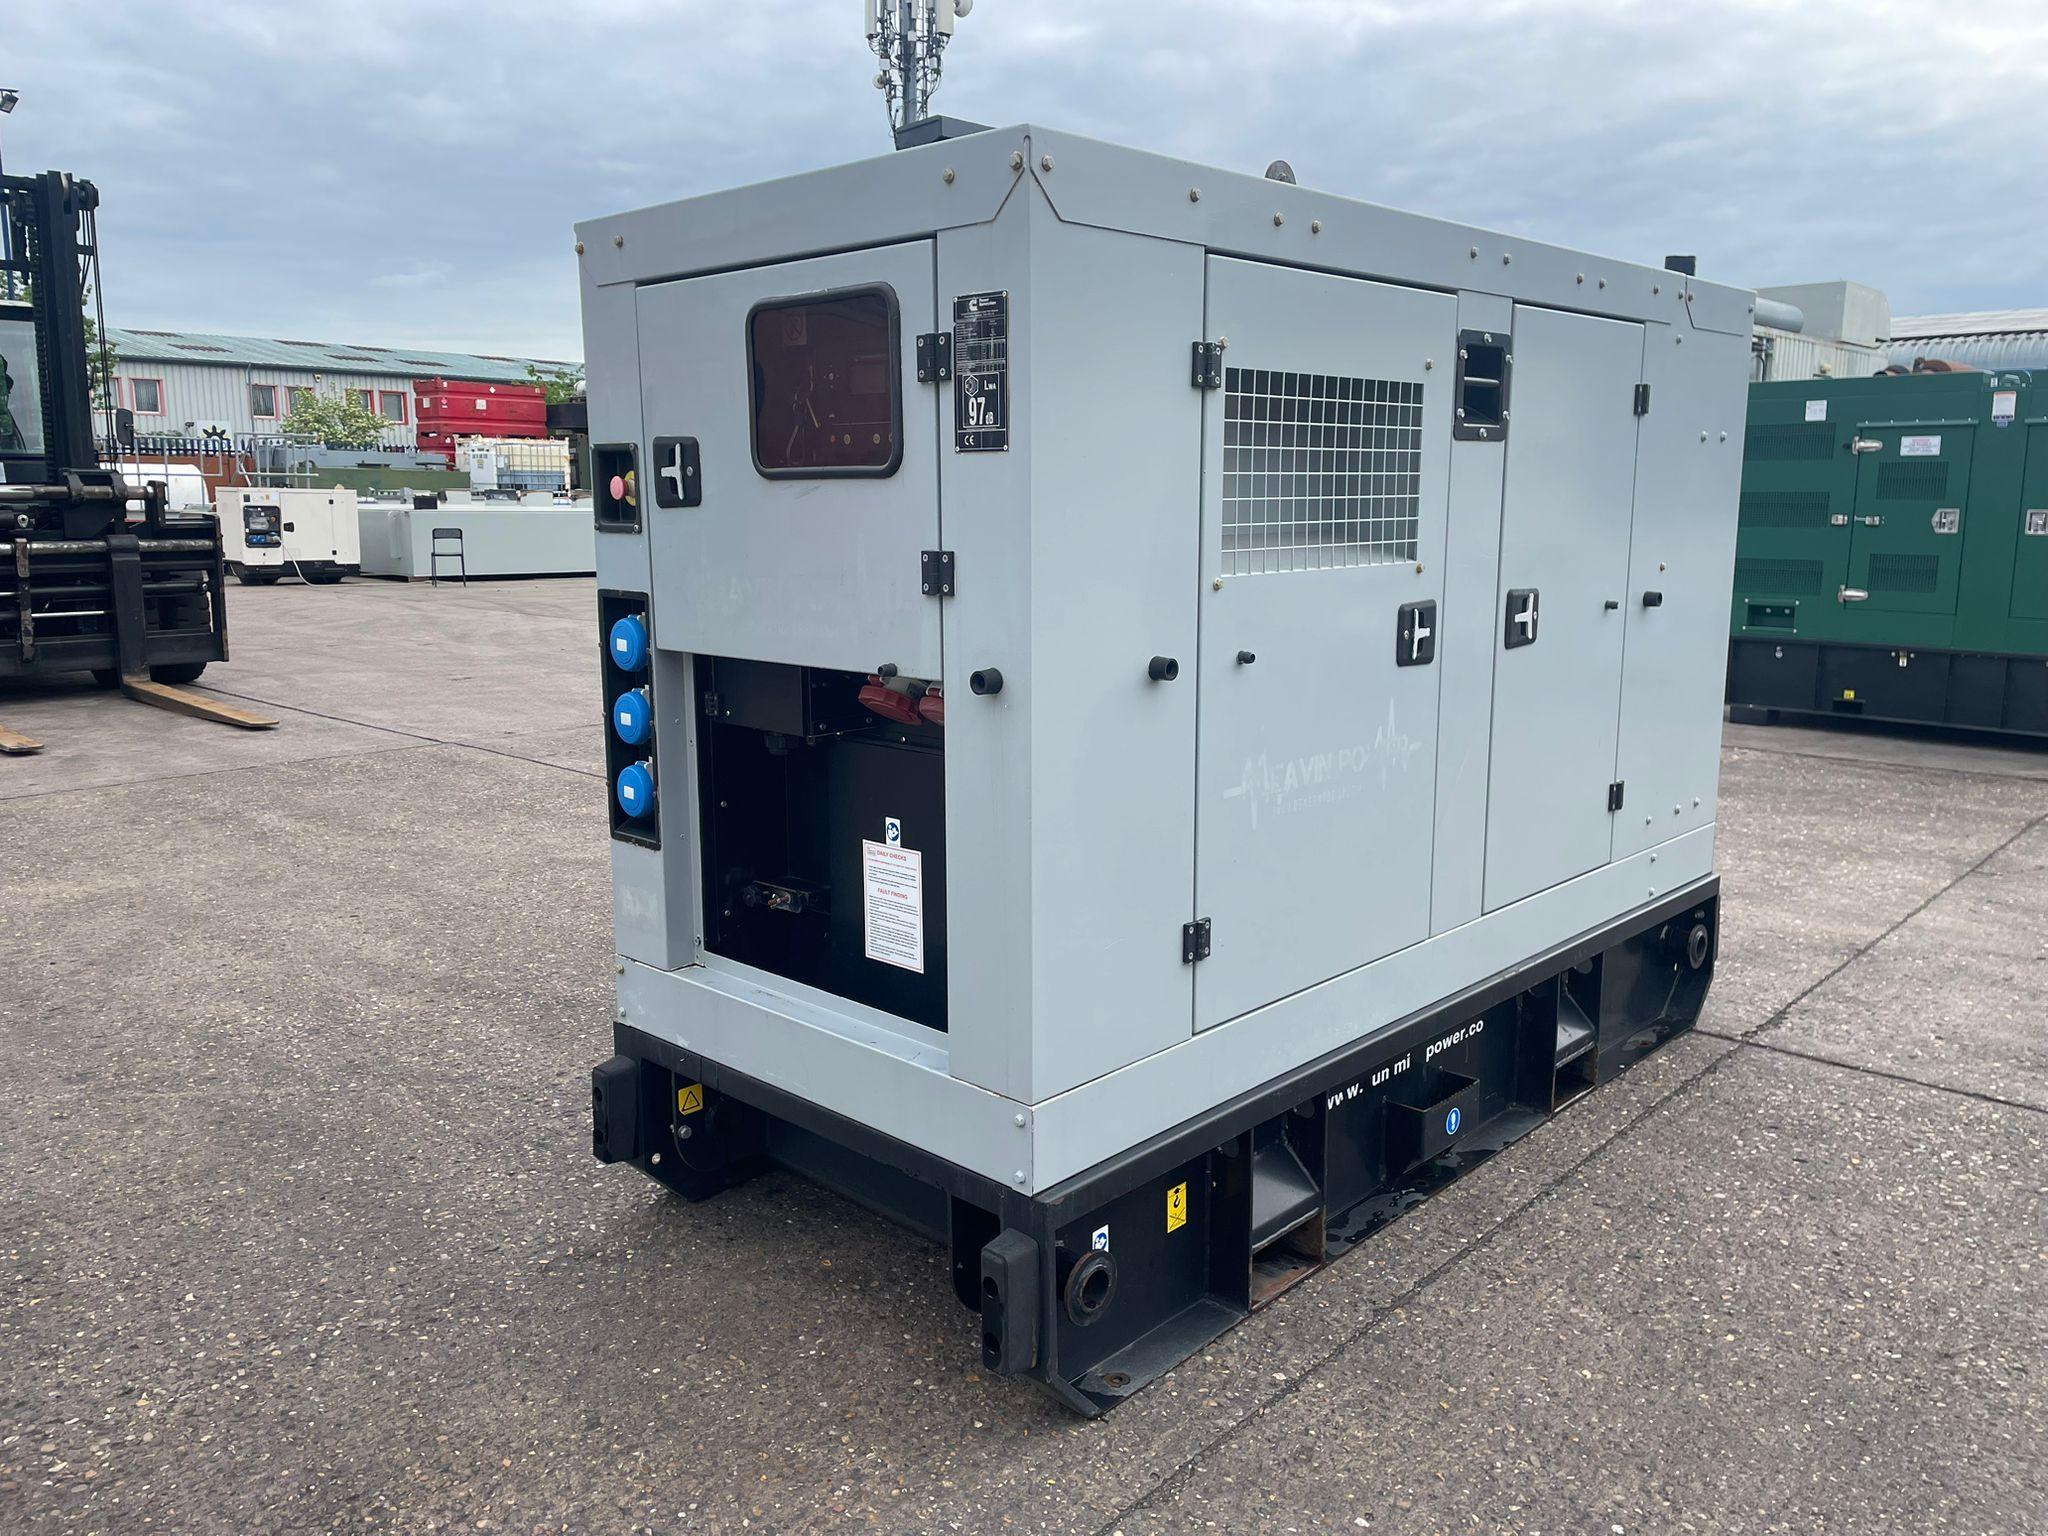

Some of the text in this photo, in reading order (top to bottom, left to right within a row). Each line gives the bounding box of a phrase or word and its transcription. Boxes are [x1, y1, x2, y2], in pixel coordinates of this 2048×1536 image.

[968, 397, 986, 426] 97
[964, 435, 975, 446] CE
[876, 849, 889, 858] DAILY
[1425, 1020, 1484, 1063] power.co
